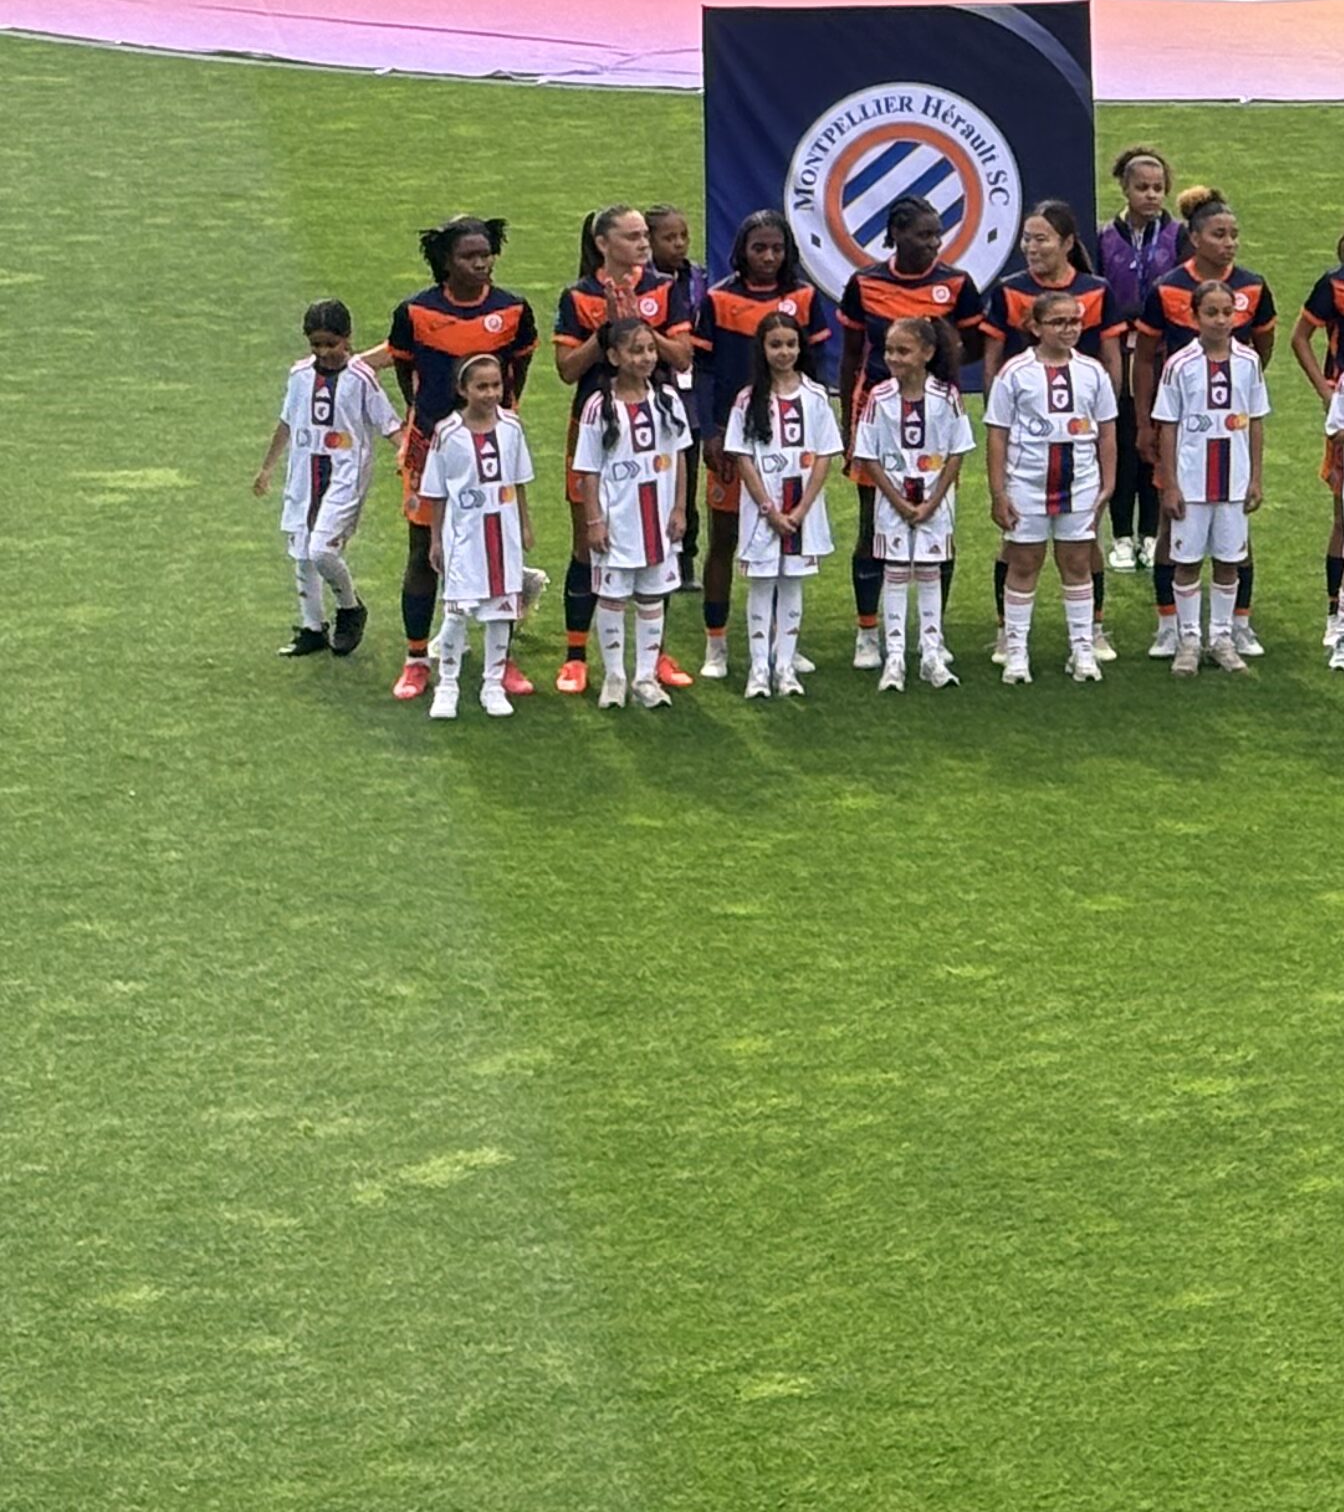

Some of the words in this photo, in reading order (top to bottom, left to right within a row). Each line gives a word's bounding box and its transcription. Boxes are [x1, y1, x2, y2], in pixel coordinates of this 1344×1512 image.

[793, 95, 915, 212] MONTPELLIER
[920, 93, 1001, 166] Hérault
[986, 169, 1011, 207] SC
